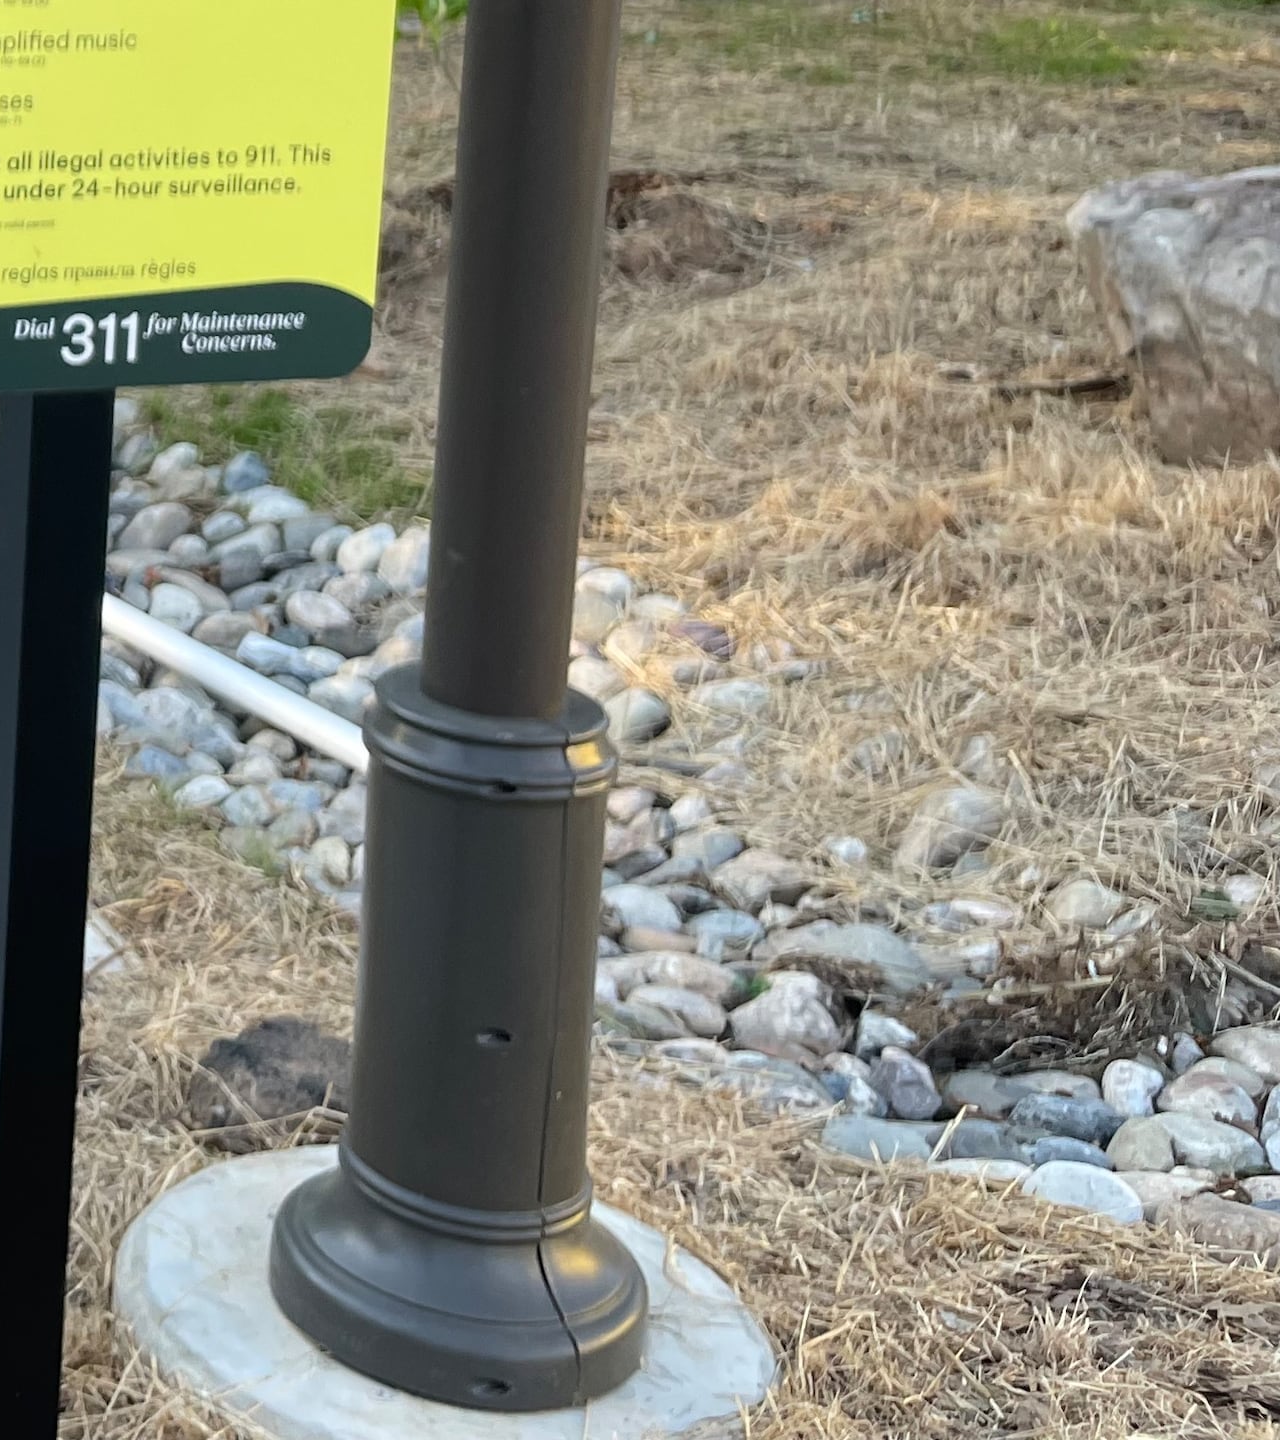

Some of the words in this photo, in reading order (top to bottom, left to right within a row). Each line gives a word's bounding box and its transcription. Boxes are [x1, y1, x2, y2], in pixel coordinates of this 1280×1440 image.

[75, 28, 138, 51] music
[6, 151, 32, 171] all
[38, 149, 104, 176] illegal
[109, 146, 210, 170] activities
[216, 147, 238, 167] to
[245, 145, 282, 167] 911.
[289, 143, 332, 165] This
[3, 178, 66, 201] under
[72, 176, 164, 199] 24-hour
[168, 172, 303, 198] surveillance.
[1, 262, 59, 285] reglas
[140, 257, 197, 281] règles
[14, 317, 55, 340] Dial
[60, 310, 139, 367] 311
[143, 312, 177, 340] for
[180, 310, 306, 334] Maintenance
[181, 332, 278, 354] Concerns.
